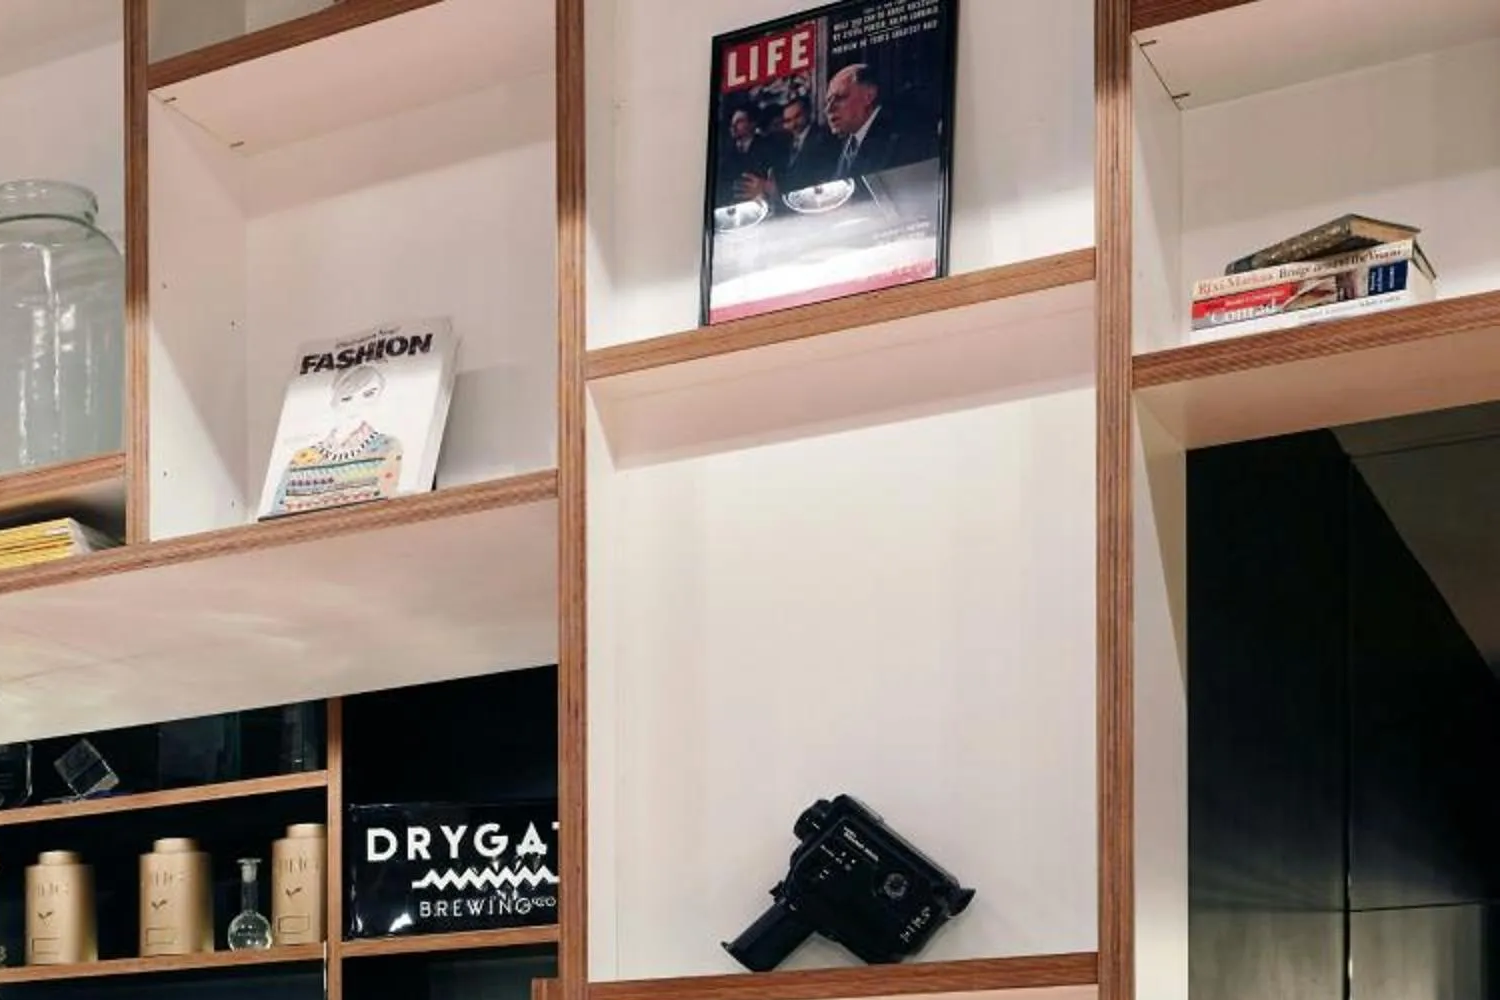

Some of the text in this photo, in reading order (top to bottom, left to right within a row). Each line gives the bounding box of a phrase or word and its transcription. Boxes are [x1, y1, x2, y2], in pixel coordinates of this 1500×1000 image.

[726, 31, 811, 88] LIFE
[299, 332, 434, 376] FASHION
[366, 820, 560, 863] DRYGA
[419, 897, 532, 919] BREWING
